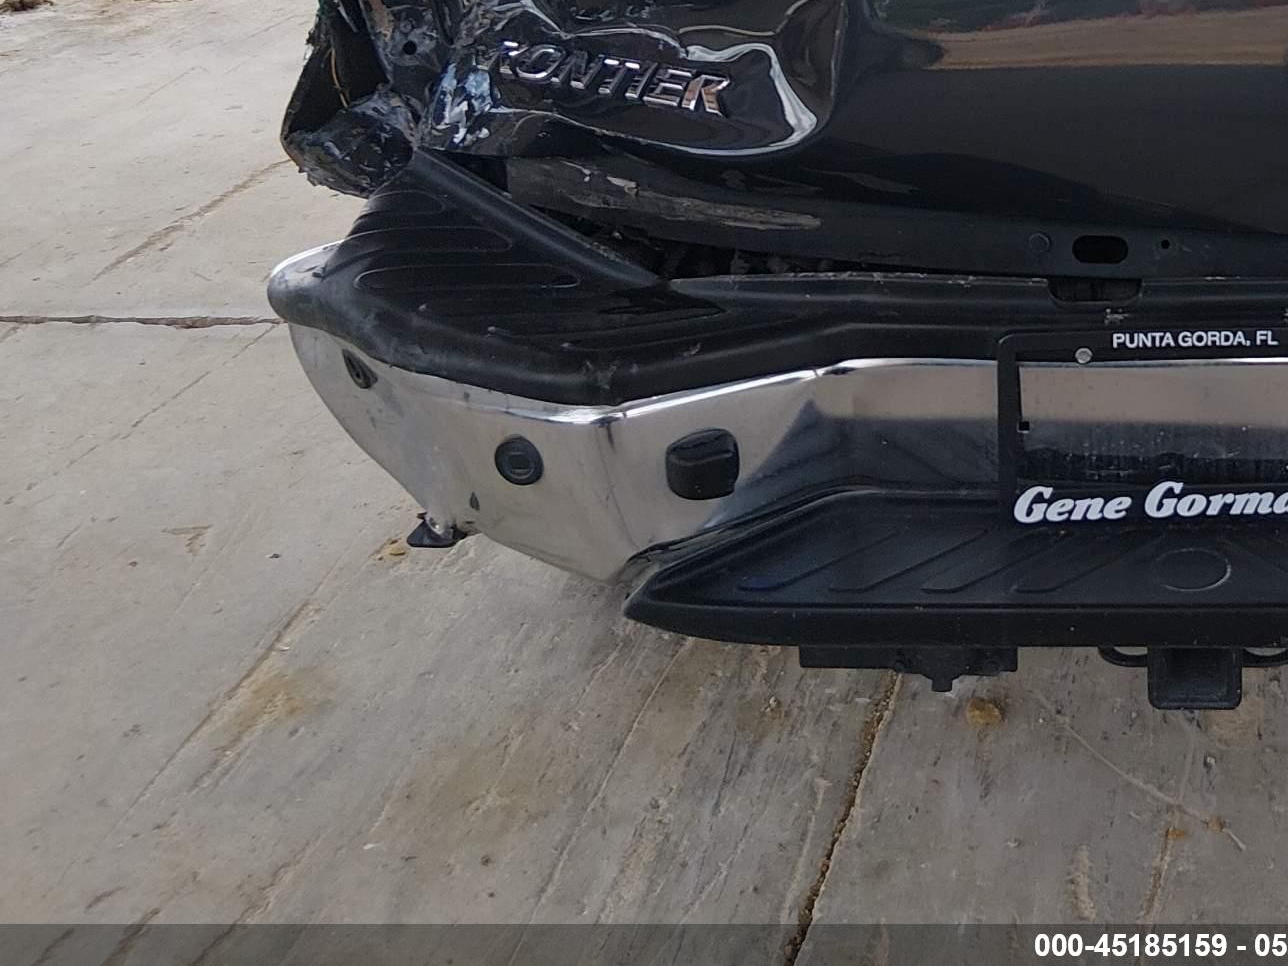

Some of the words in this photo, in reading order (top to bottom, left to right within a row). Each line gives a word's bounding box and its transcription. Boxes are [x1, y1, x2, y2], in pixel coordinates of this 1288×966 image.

[1112, 332, 1175, 349] PUNTA
[1178, 330, 1251, 348] GORDA,
[1256, 330, 1279, 346] FL
[1014, 486, 1132, 524] Gene
